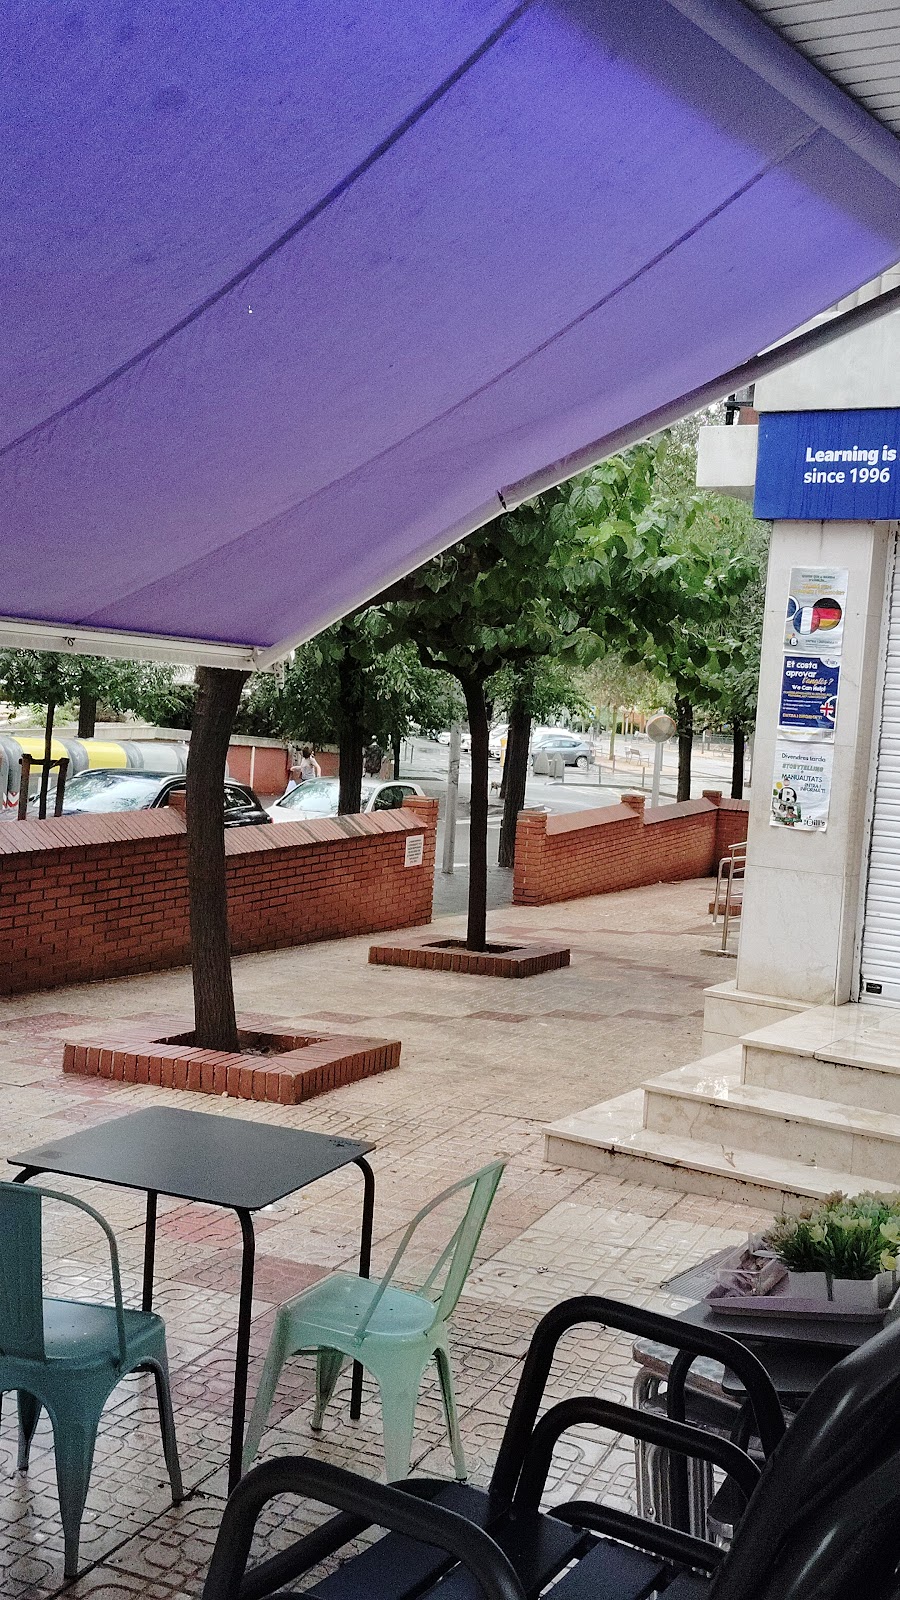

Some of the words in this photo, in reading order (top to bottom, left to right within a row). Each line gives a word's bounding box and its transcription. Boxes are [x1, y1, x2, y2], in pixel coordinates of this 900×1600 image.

[806, 446, 878, 466] Learning
[882, 445, 896, 461] is
[804, 468, 845, 484] since
[850, 468, 890, 483] 1996
[786, 670, 817, 678] aprovar
[782, 763, 824, 772] STORYTELLING
[782, 774, 822, 782] MANUALITATS
